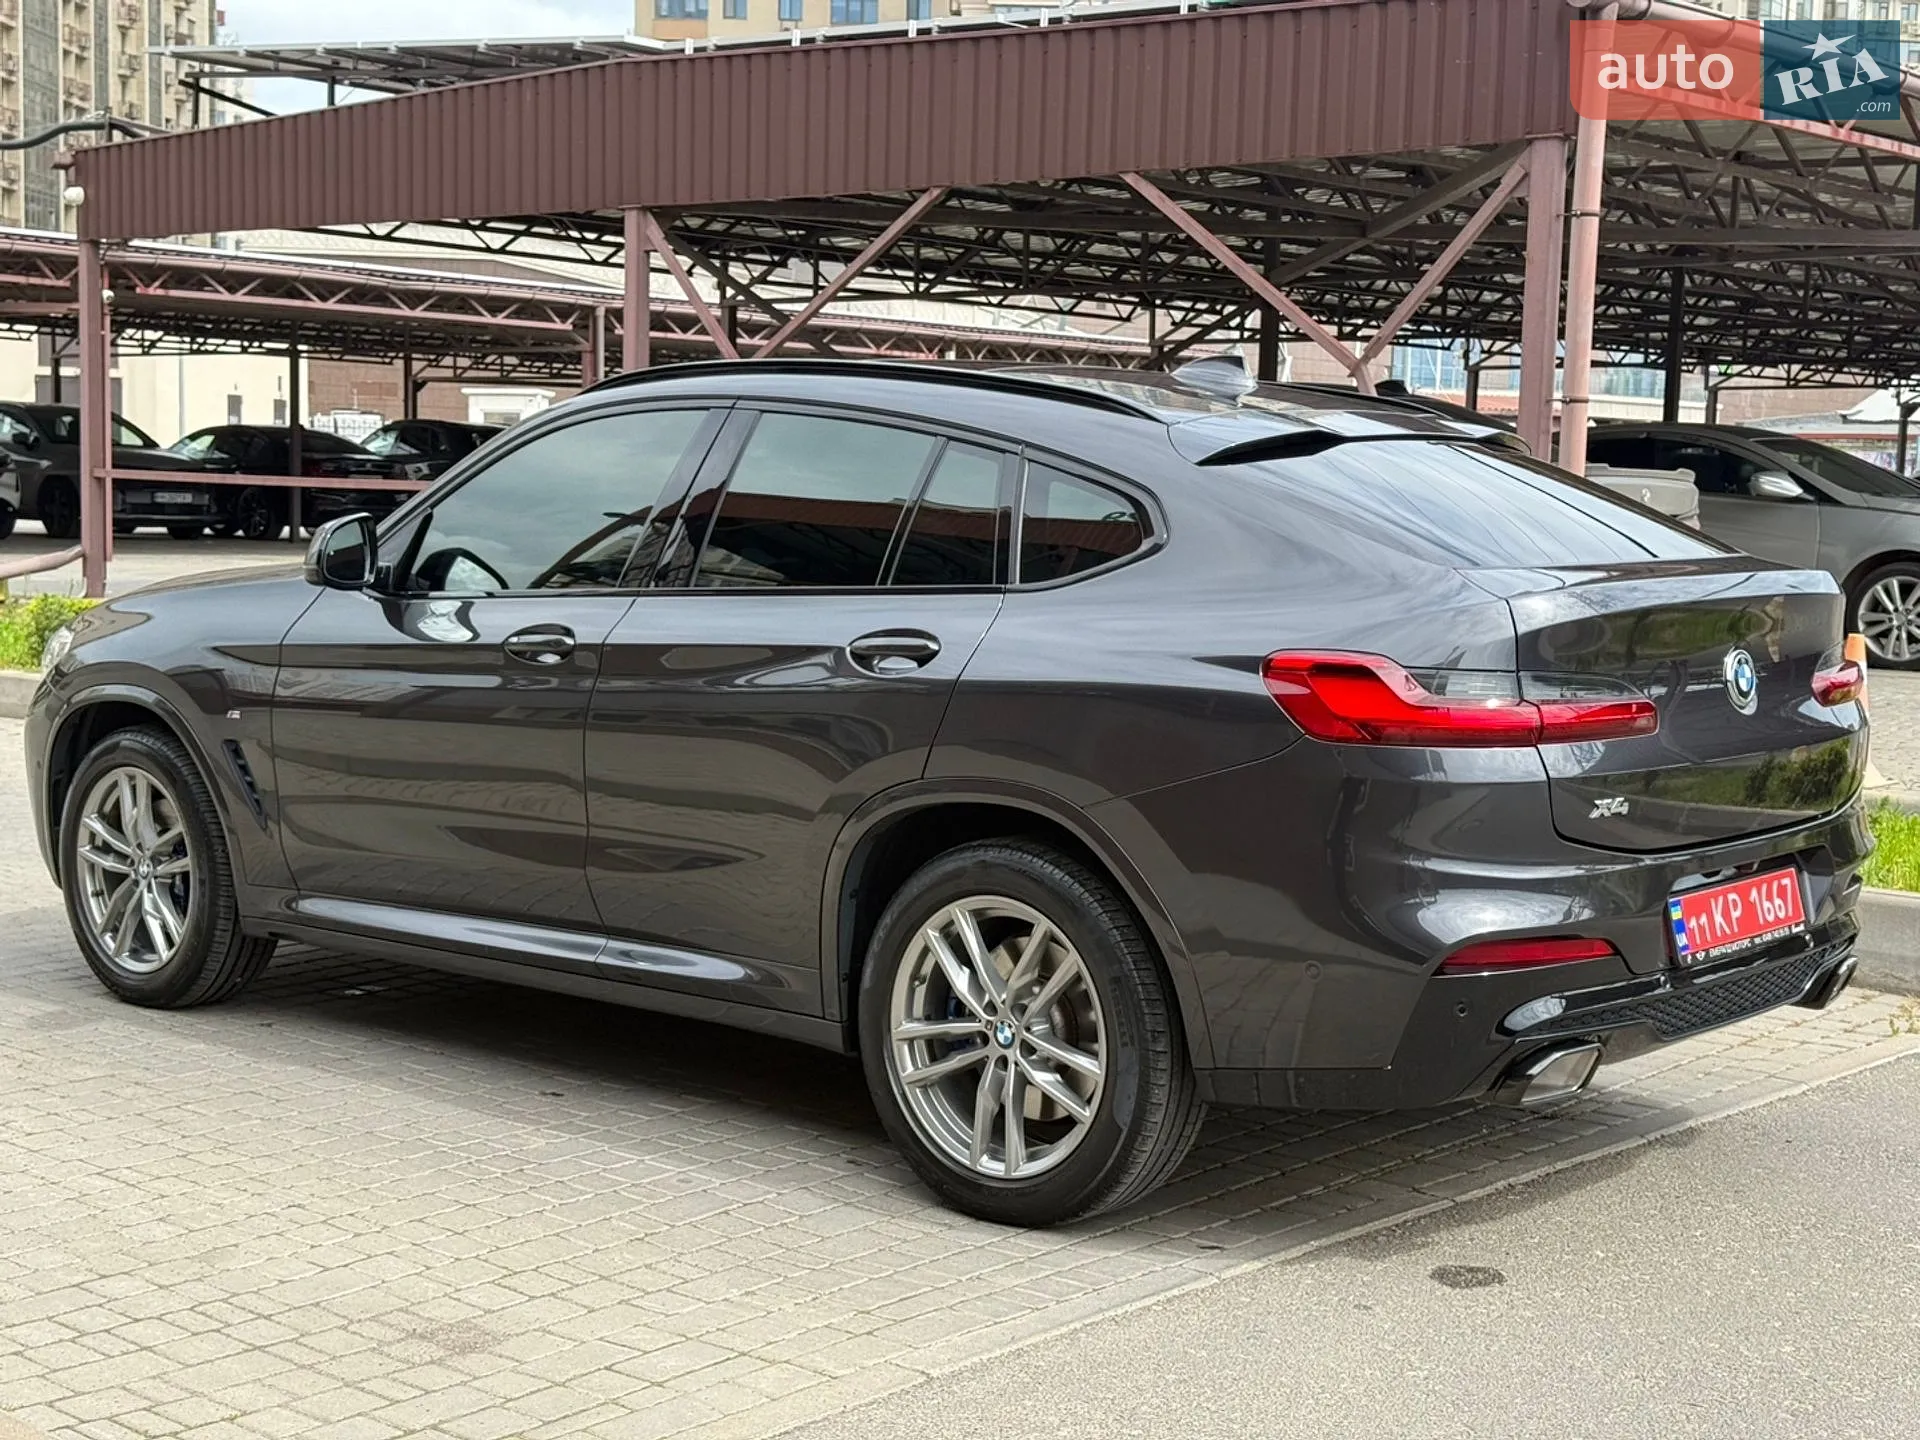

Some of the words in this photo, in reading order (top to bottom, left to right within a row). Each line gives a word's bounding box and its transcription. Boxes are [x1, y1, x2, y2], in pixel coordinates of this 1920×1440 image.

[1588, 797, 1629, 818] X4
[1750, 876, 1793, 926] 1667
[1675, 933, 1688, 947] UA
